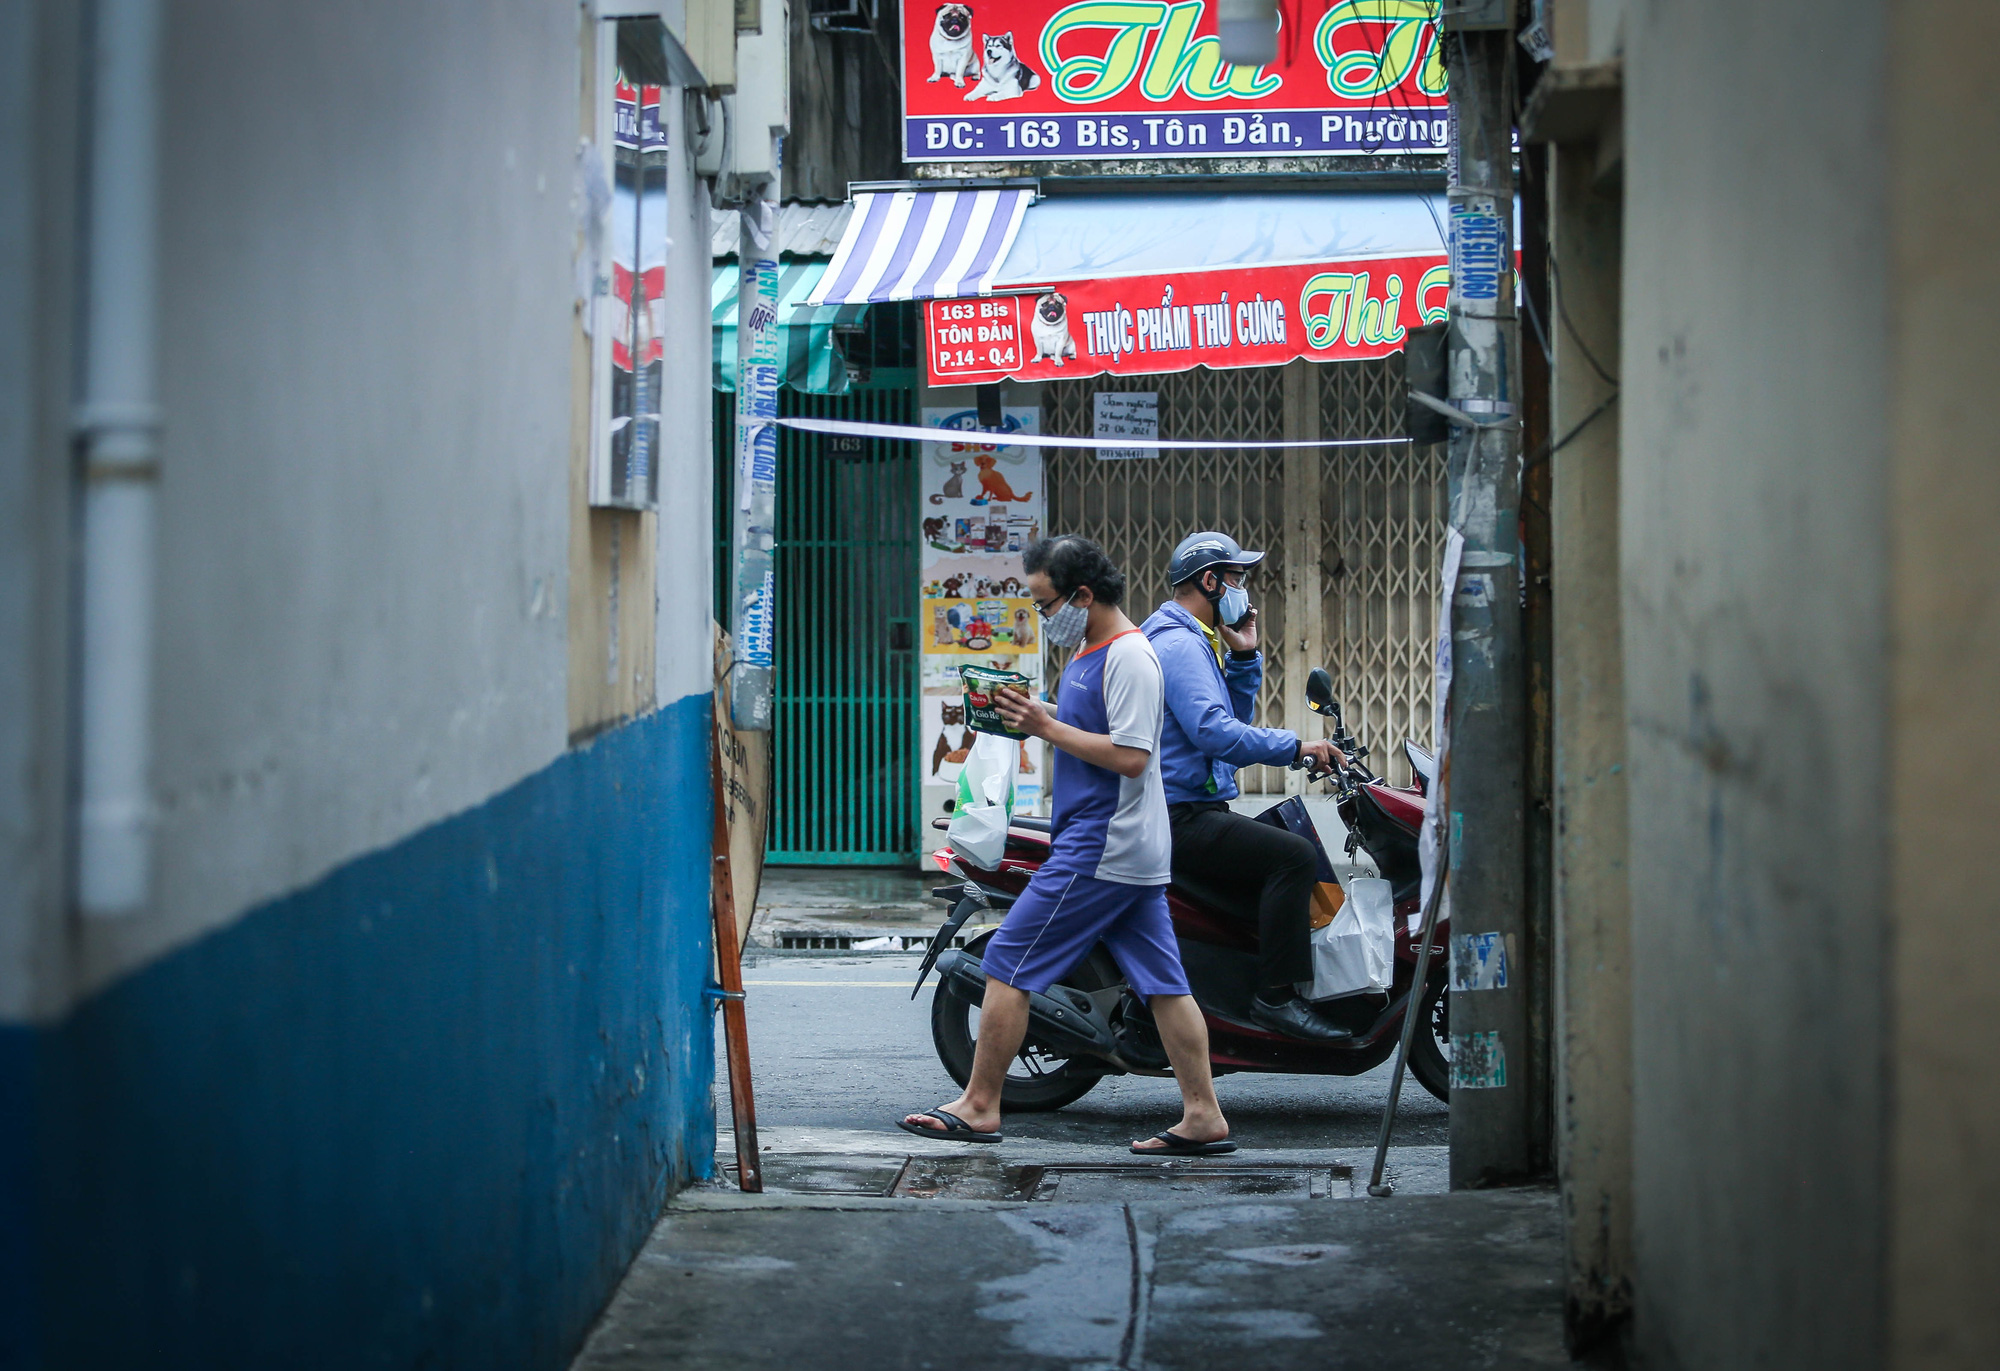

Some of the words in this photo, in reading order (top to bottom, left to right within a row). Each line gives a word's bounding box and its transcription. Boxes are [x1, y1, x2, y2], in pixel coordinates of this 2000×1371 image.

[925, 121, 985, 150] ĐC:
[999, 120, 1061, 148] 163
[1222, 113, 1304, 148] Đản,
[1321, 112, 1449, 147] Phường
[940, 303, 975, 321] 163
[979, 302, 1009, 318] Bis
[1082, 302, 1135, 364] THỰC
[1136, 283, 1192, 353] PHẨM
[1192, 290, 1232, 350] THÚ
[1299, 270, 1406, 351] Thi
[937, 324, 974, 345] TÔN
[977, 319, 1014, 343] ĐẢN
[939, 349, 975, 368] P.14
[988, 346, 1016, 367] Q.4
[831, 437, 861, 452] 163
